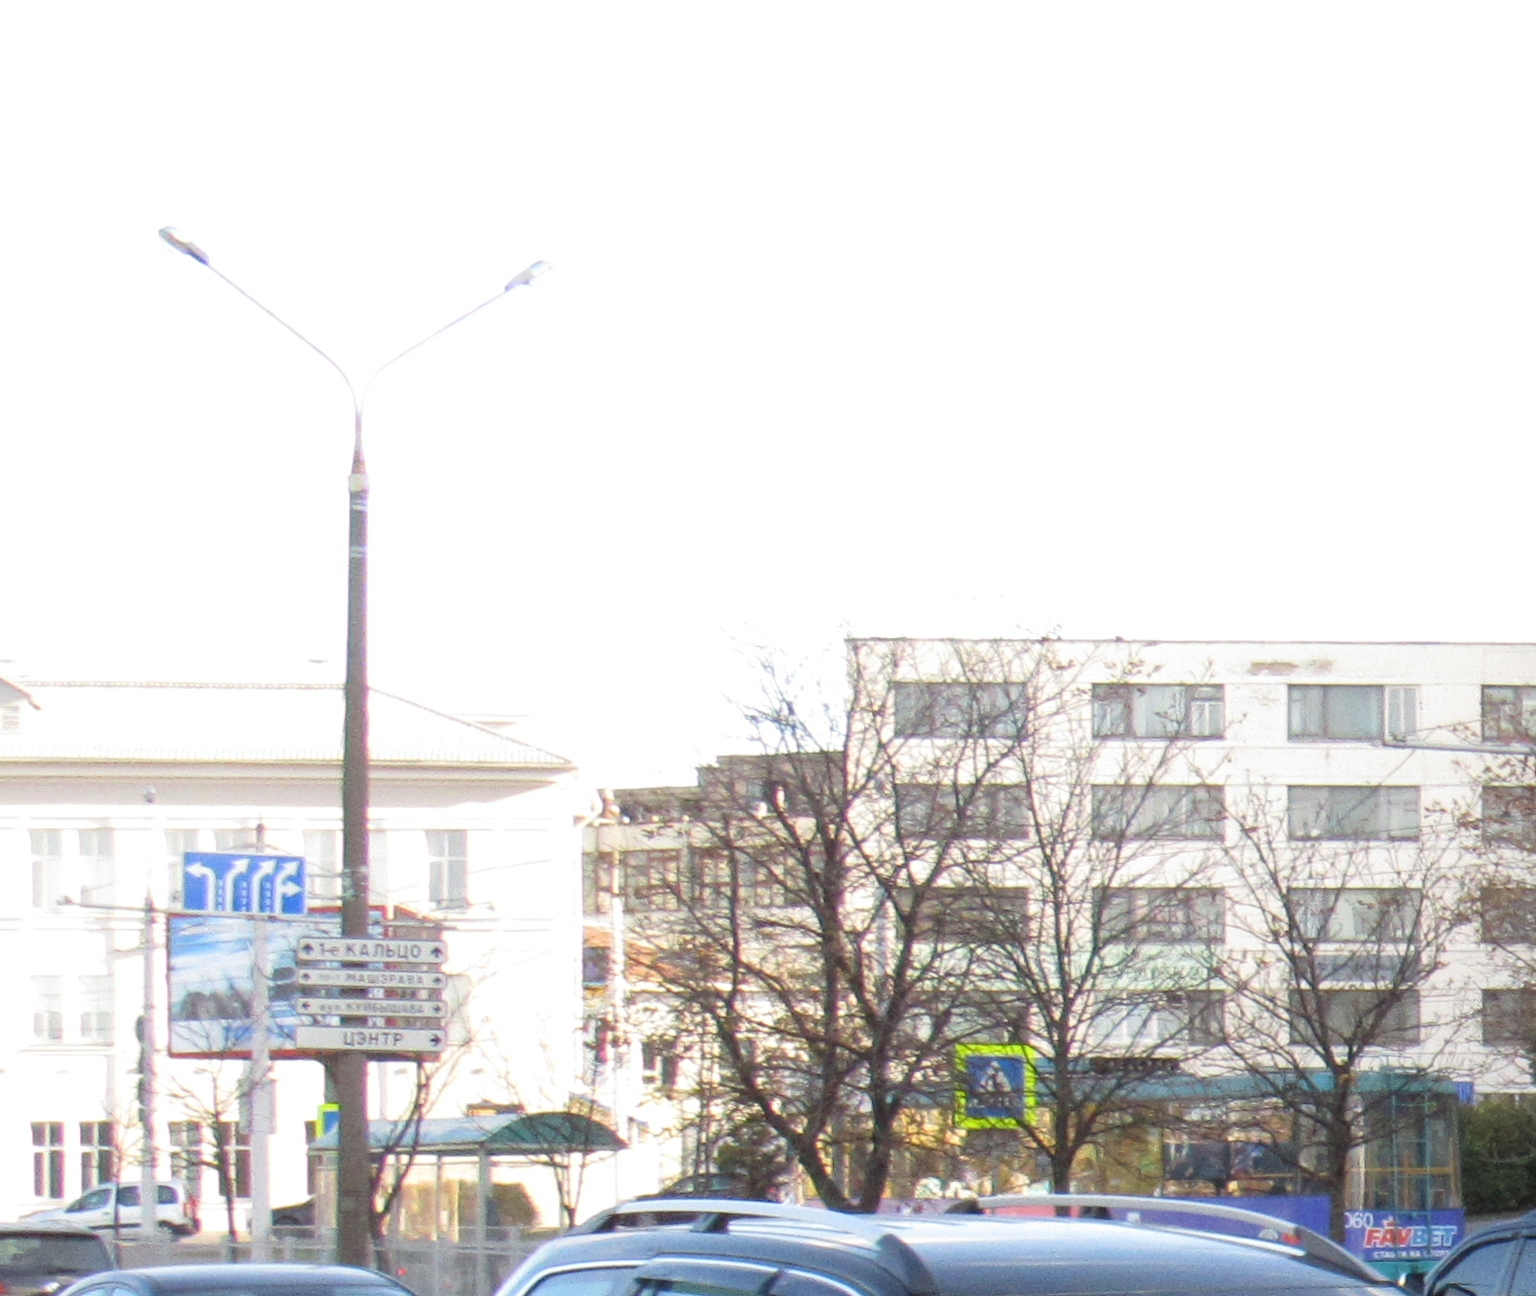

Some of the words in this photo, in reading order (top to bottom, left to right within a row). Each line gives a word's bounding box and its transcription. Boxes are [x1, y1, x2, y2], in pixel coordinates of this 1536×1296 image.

[345, 943, 422, 960] КАЛЬЦО
[345, 973, 424, 985] МАШЭРАВА
[342, 1031, 404, 1047] ЦЭНТР
[1363, 1226, 1458, 1248] FAVBET
